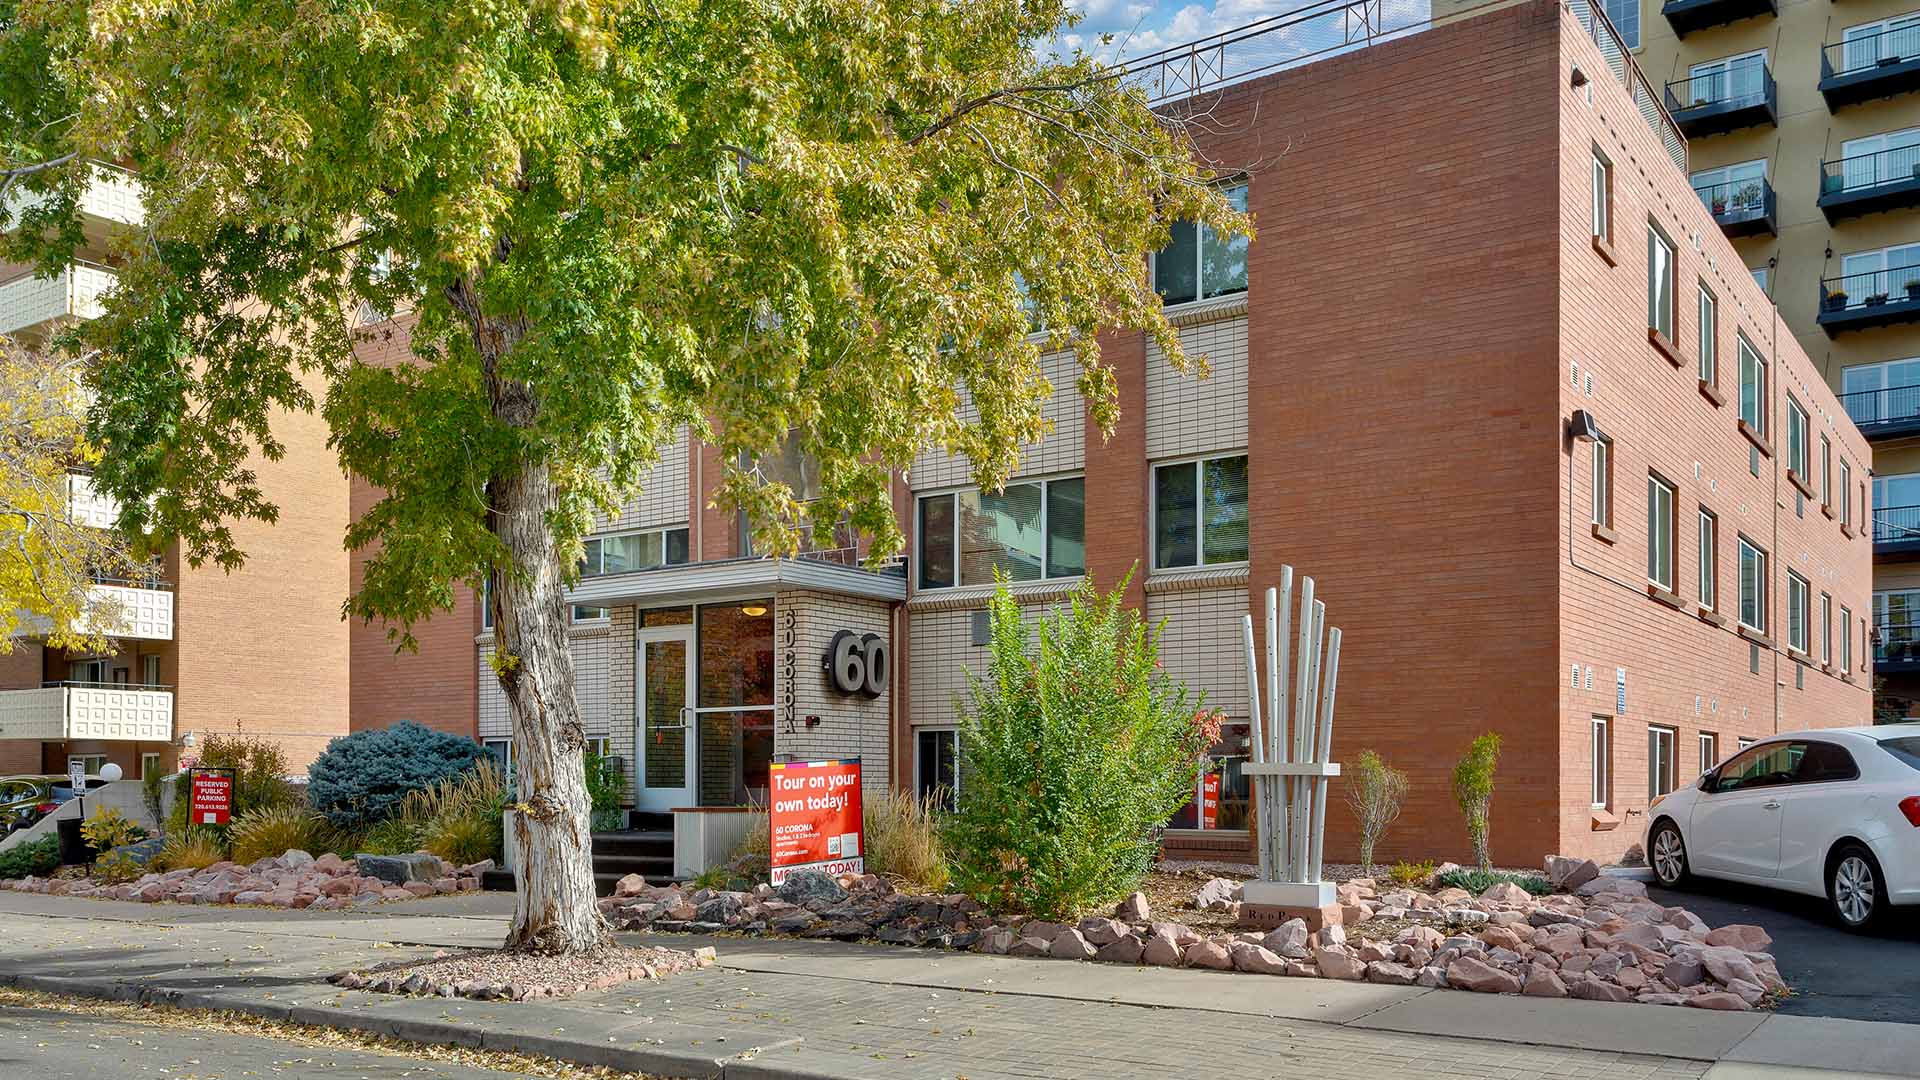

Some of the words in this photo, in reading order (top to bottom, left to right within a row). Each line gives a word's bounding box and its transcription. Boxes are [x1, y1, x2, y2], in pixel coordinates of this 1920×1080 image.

[784, 609, 796, 647] 60
[831, 630, 890, 699] 60
[784, 650, 796, 734] CORONA
[775, 774, 806, 791] Tour
[808, 775, 825, 789] on
[828, 773, 856, 791] your
[775, 799, 804, 813] own
[807, 791, 849, 812] today!
[775, 826, 784, 834] 60
[784, 823, 814, 833] CORONA
[823, 861, 860, 874] TODAY!
